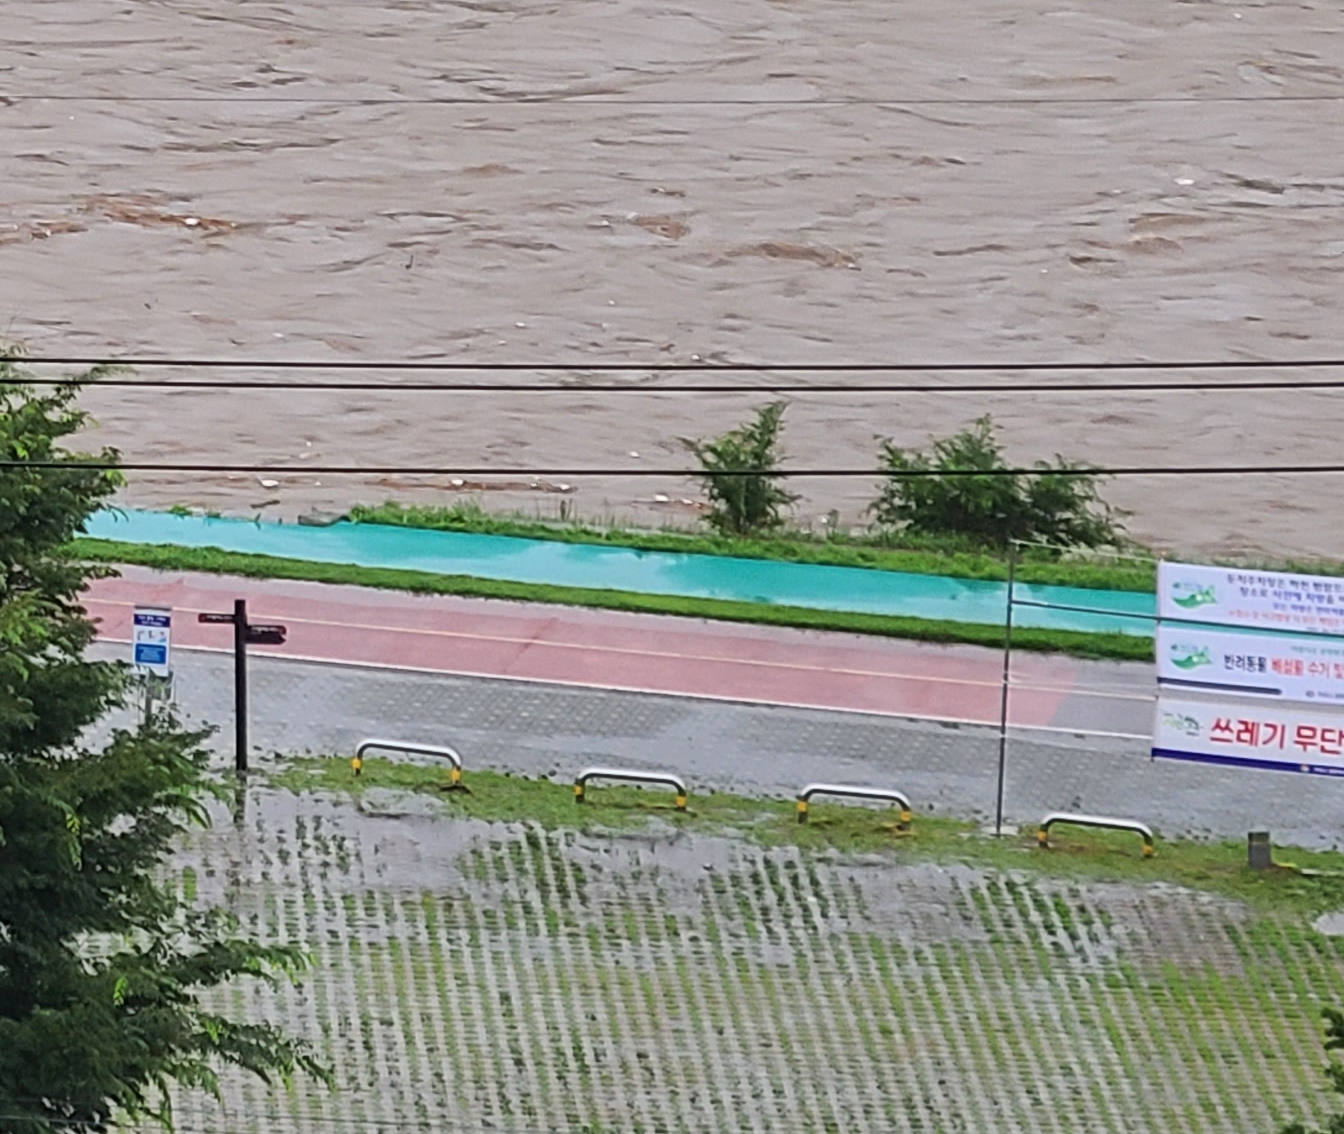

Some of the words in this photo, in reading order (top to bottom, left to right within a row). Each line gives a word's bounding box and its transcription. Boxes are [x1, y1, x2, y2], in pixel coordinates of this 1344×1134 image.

[1223, 653, 1268, 673] 반려동물
[1209, 717, 1287, 750] 쓰레기
[1292, 724, 1344, 756] 무단
